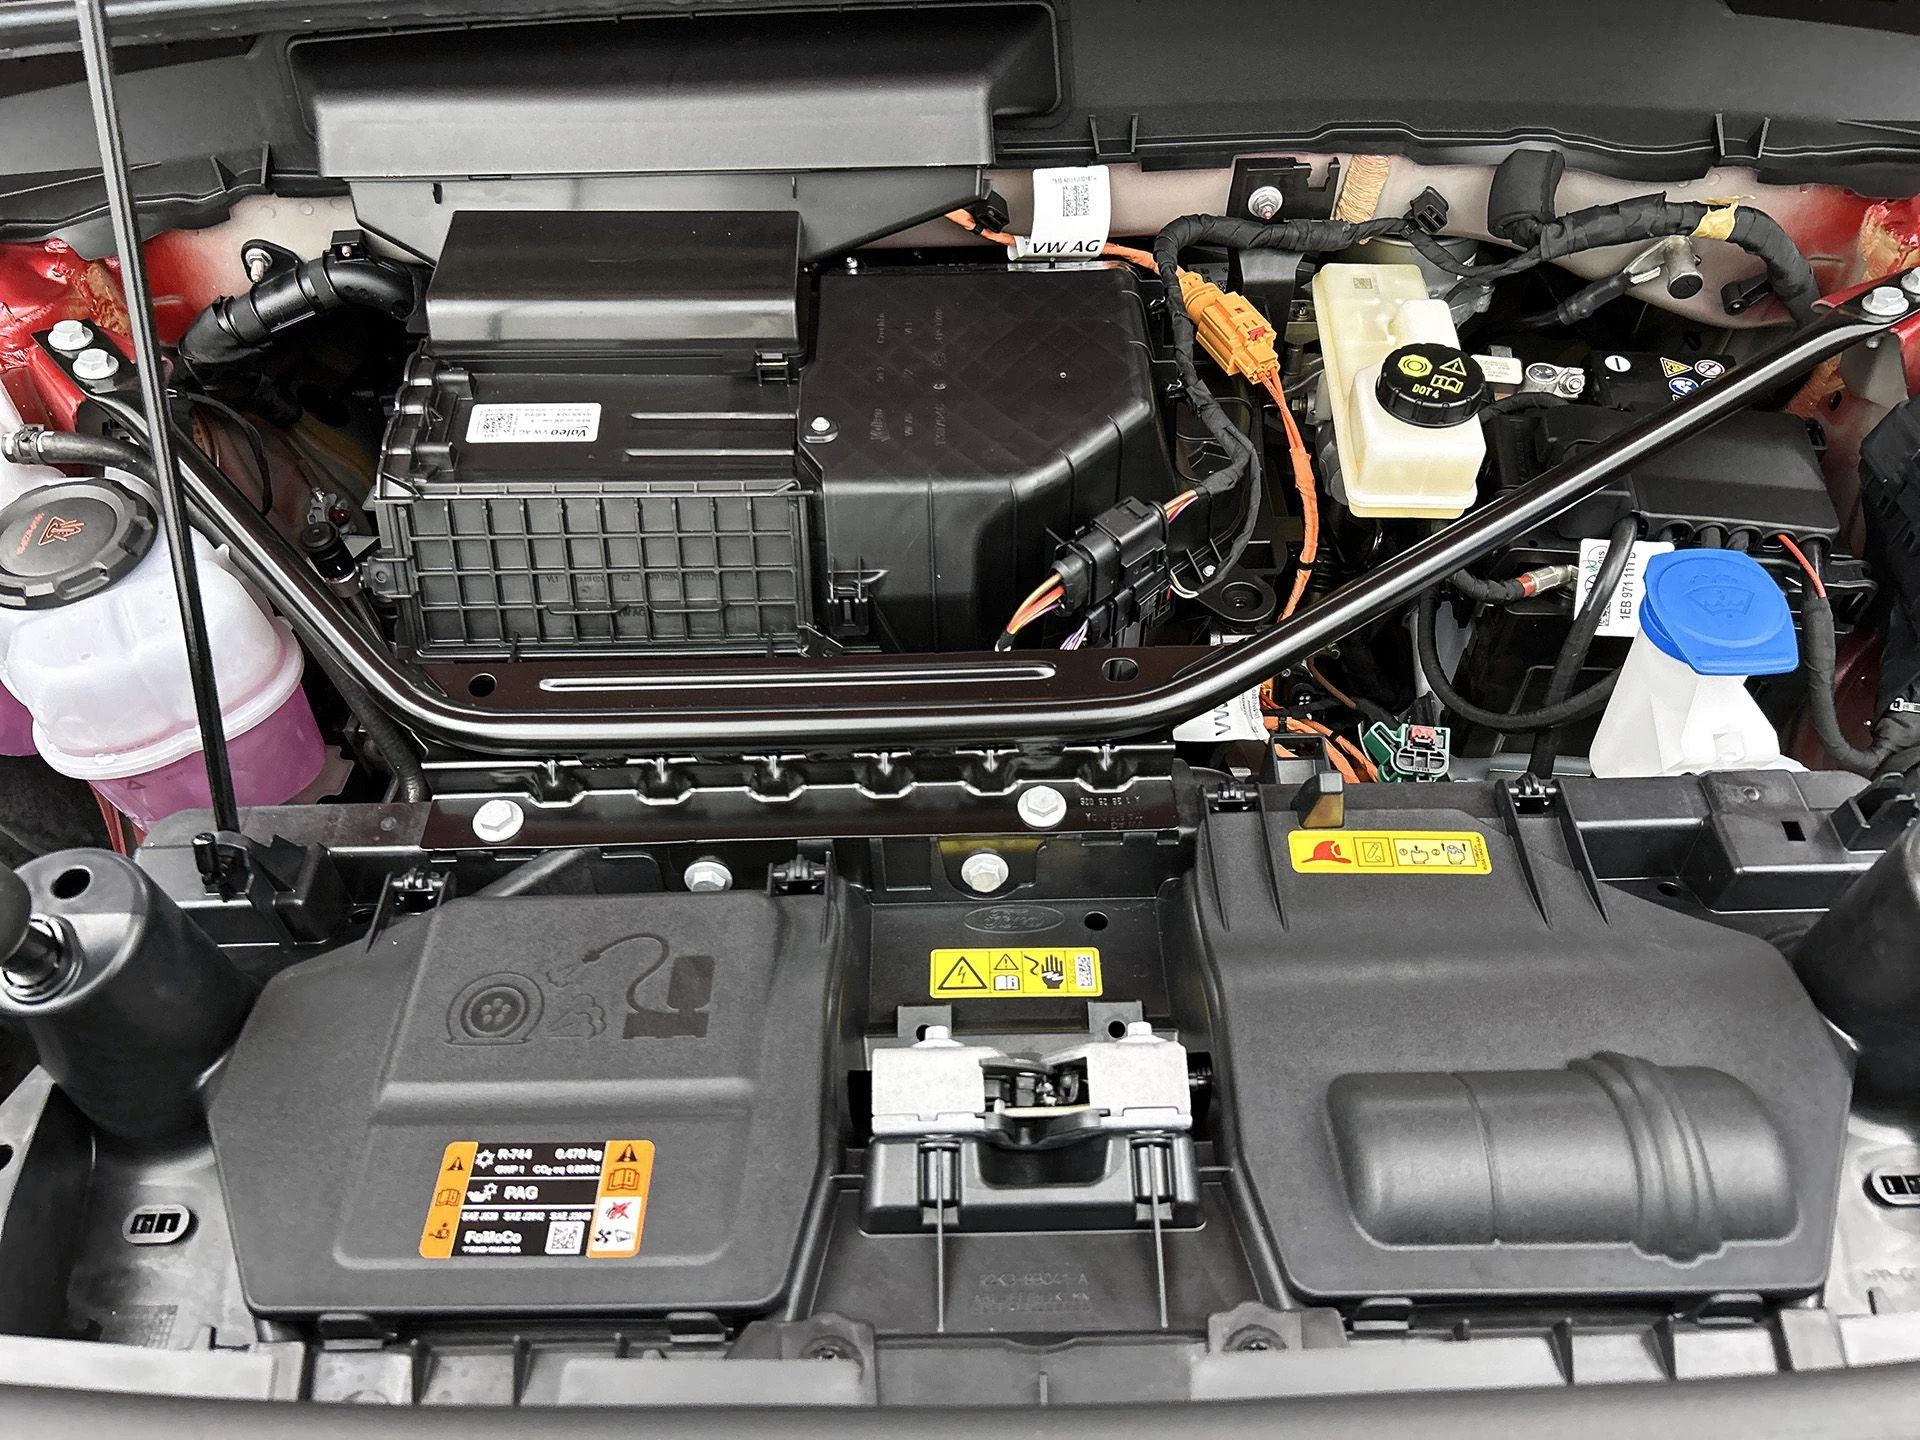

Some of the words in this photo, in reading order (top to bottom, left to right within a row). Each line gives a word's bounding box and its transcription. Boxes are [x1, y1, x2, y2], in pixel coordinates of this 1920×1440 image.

[1033, 241, 1068, 253] VW
[1070, 240, 1101, 253] AG
[1412, 383, 1433, 396] DOT
[1432, 389, 1440, 399] 4
[551, 428, 587, 437] Valeo
[1622, 581, 1634, 598] 971
[1620, 600, 1632, 620] 1EB
[983, 908, 1046, 929] Ford
[497, 1148, 533, 1160] R-744
[503, 1185, 539, 1200] PAG
[464, 1230, 522, 1244] FoMoCo
